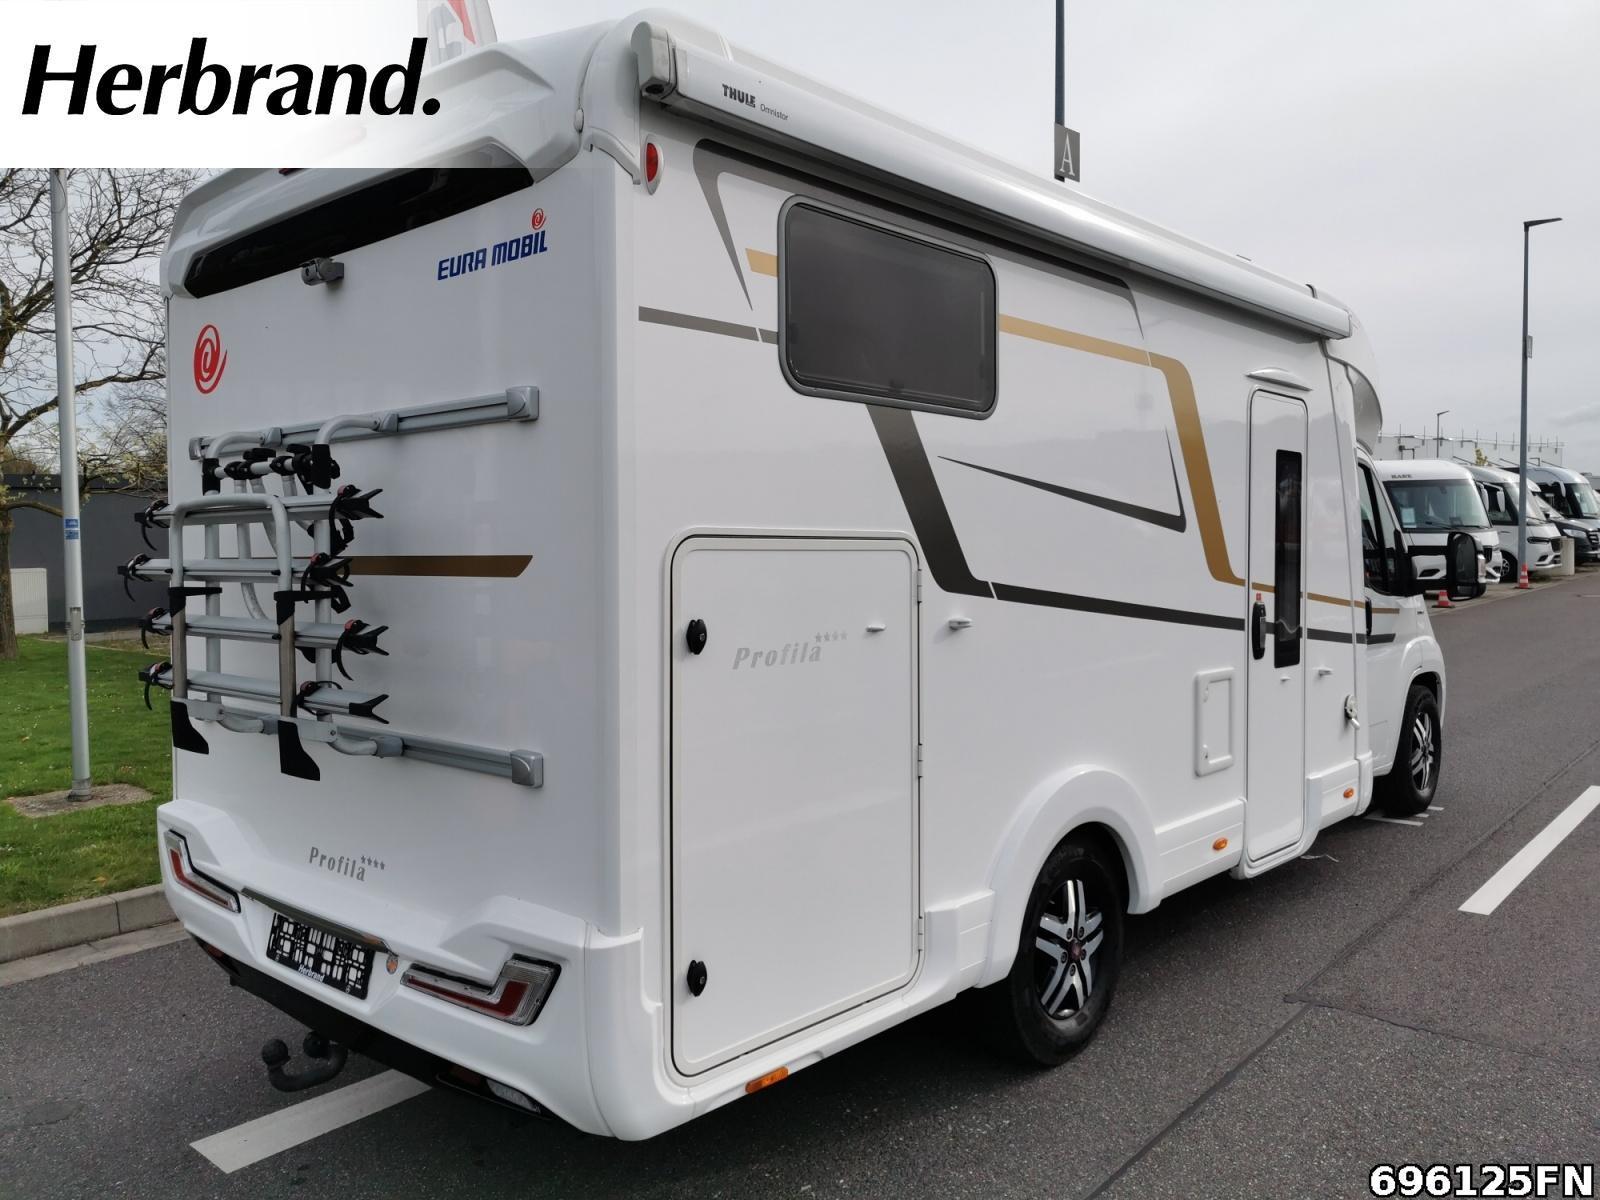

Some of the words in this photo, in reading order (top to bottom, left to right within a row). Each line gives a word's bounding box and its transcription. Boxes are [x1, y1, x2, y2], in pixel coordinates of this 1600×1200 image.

[722, 83, 756, 109] THULE
[760, 103, 789, 121] Omnistor
[1059, 132, 1076, 176] A
[437, 247, 486, 281] EURA
[491, 230, 548, 266] MOBIL
[732, 642, 822, 670] Profila
[308, 846, 366, 882] Profila
[298, 964, 326, 983] Herbrand
